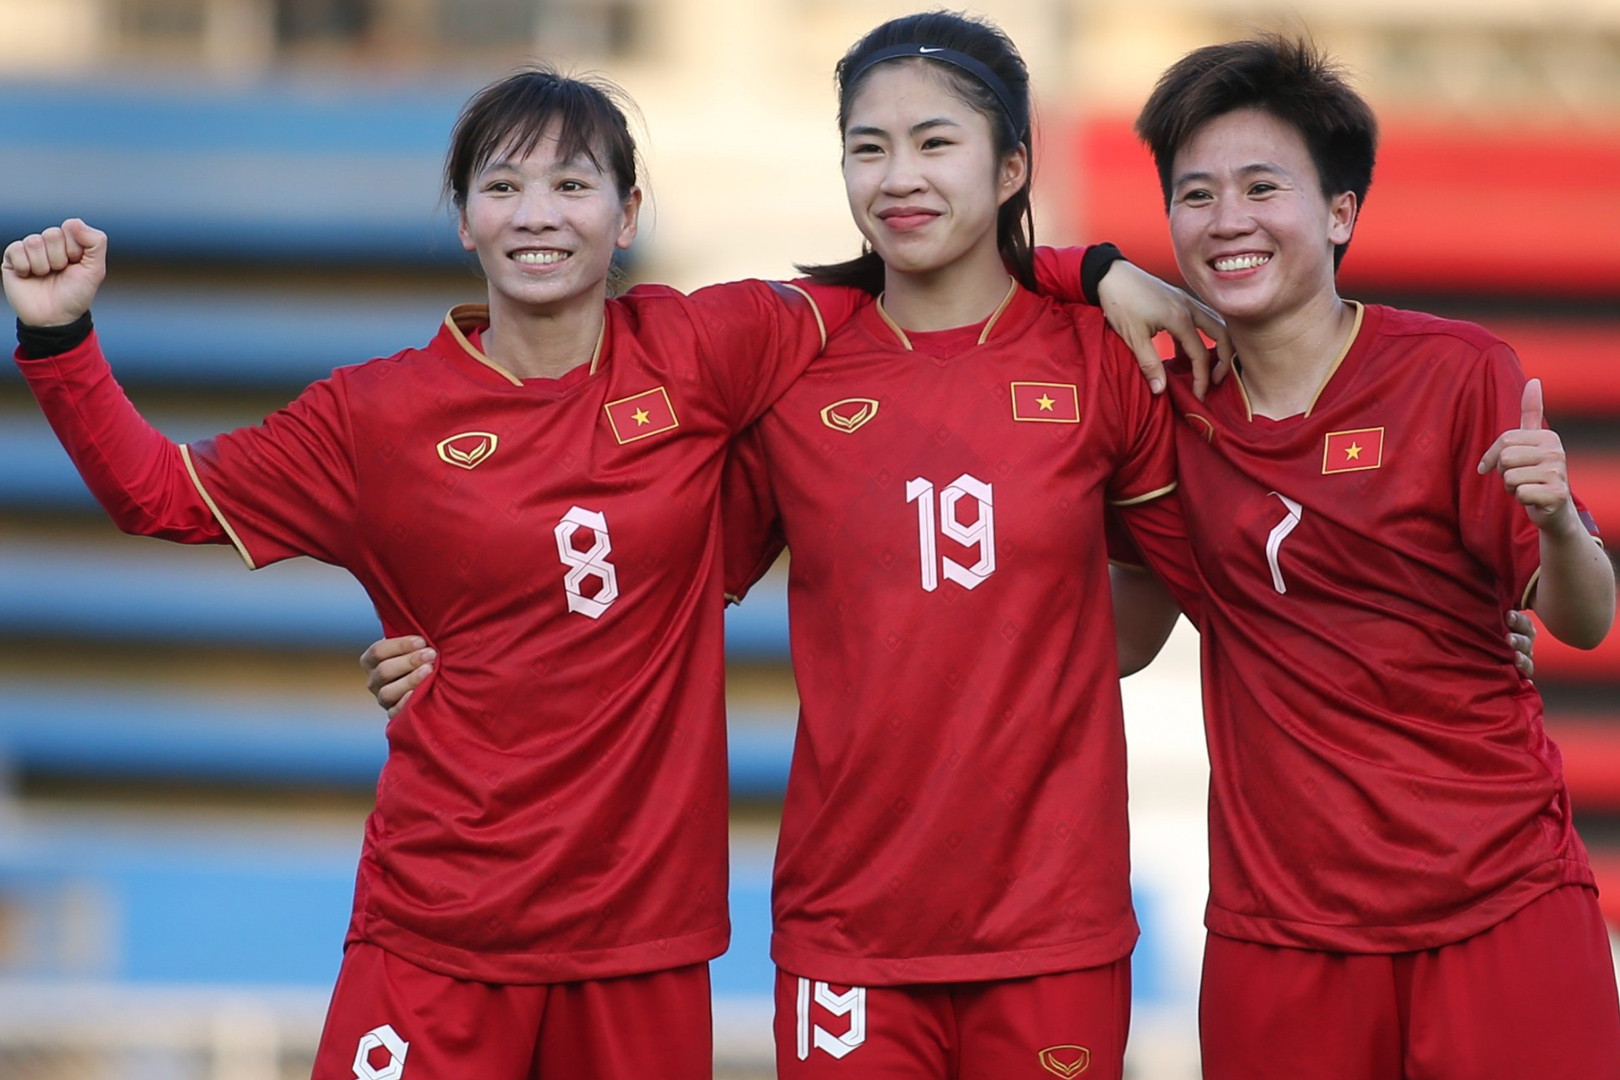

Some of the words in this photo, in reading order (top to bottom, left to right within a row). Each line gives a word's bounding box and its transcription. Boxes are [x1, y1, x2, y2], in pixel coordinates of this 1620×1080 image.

[554, 505, 619, 620] 8
[905, 473, 996, 593] 19
[1265, 491, 1303, 595] 7
[796, 976, 867, 1061] 19
